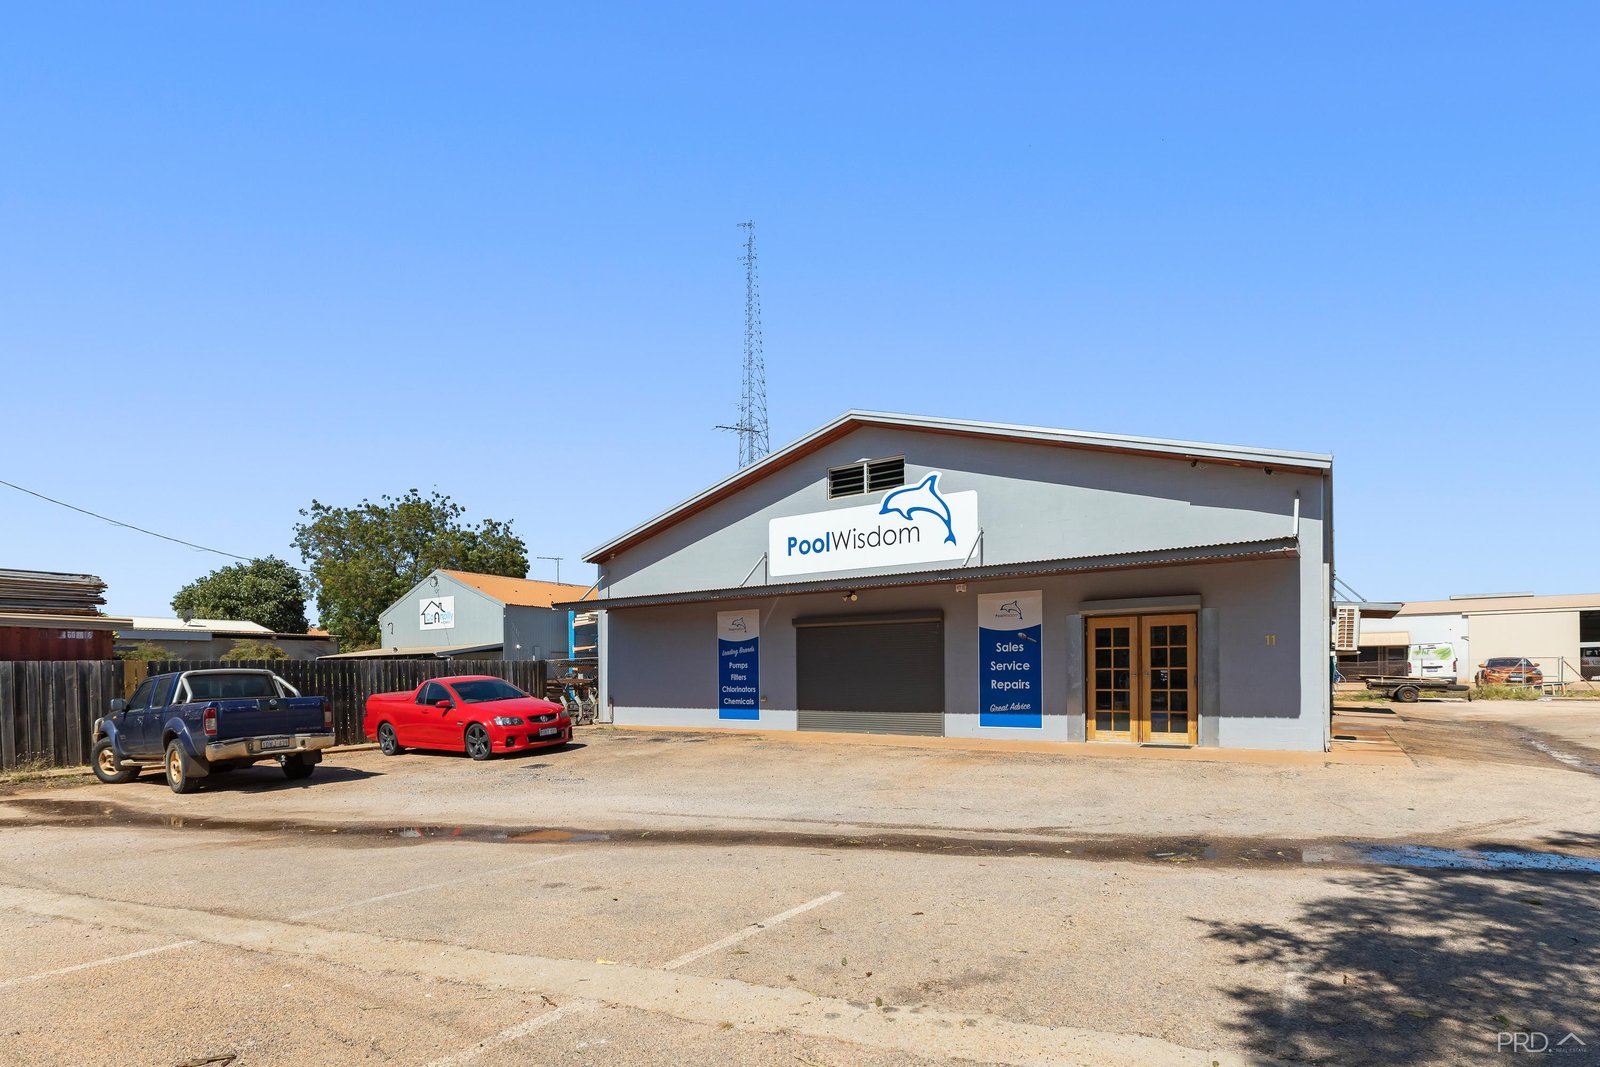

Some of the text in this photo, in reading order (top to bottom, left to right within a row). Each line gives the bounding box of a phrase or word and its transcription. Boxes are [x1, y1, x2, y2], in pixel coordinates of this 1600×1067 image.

[787, 525, 920, 556] PoolWisdom
[1264, 634, 1276, 646] 11
[996, 642, 1024, 652] Sales
[990, 660, 1030, 670] Service
[990, 679, 1030, 691] Repairs
[990, 704, 1010, 712] Great
